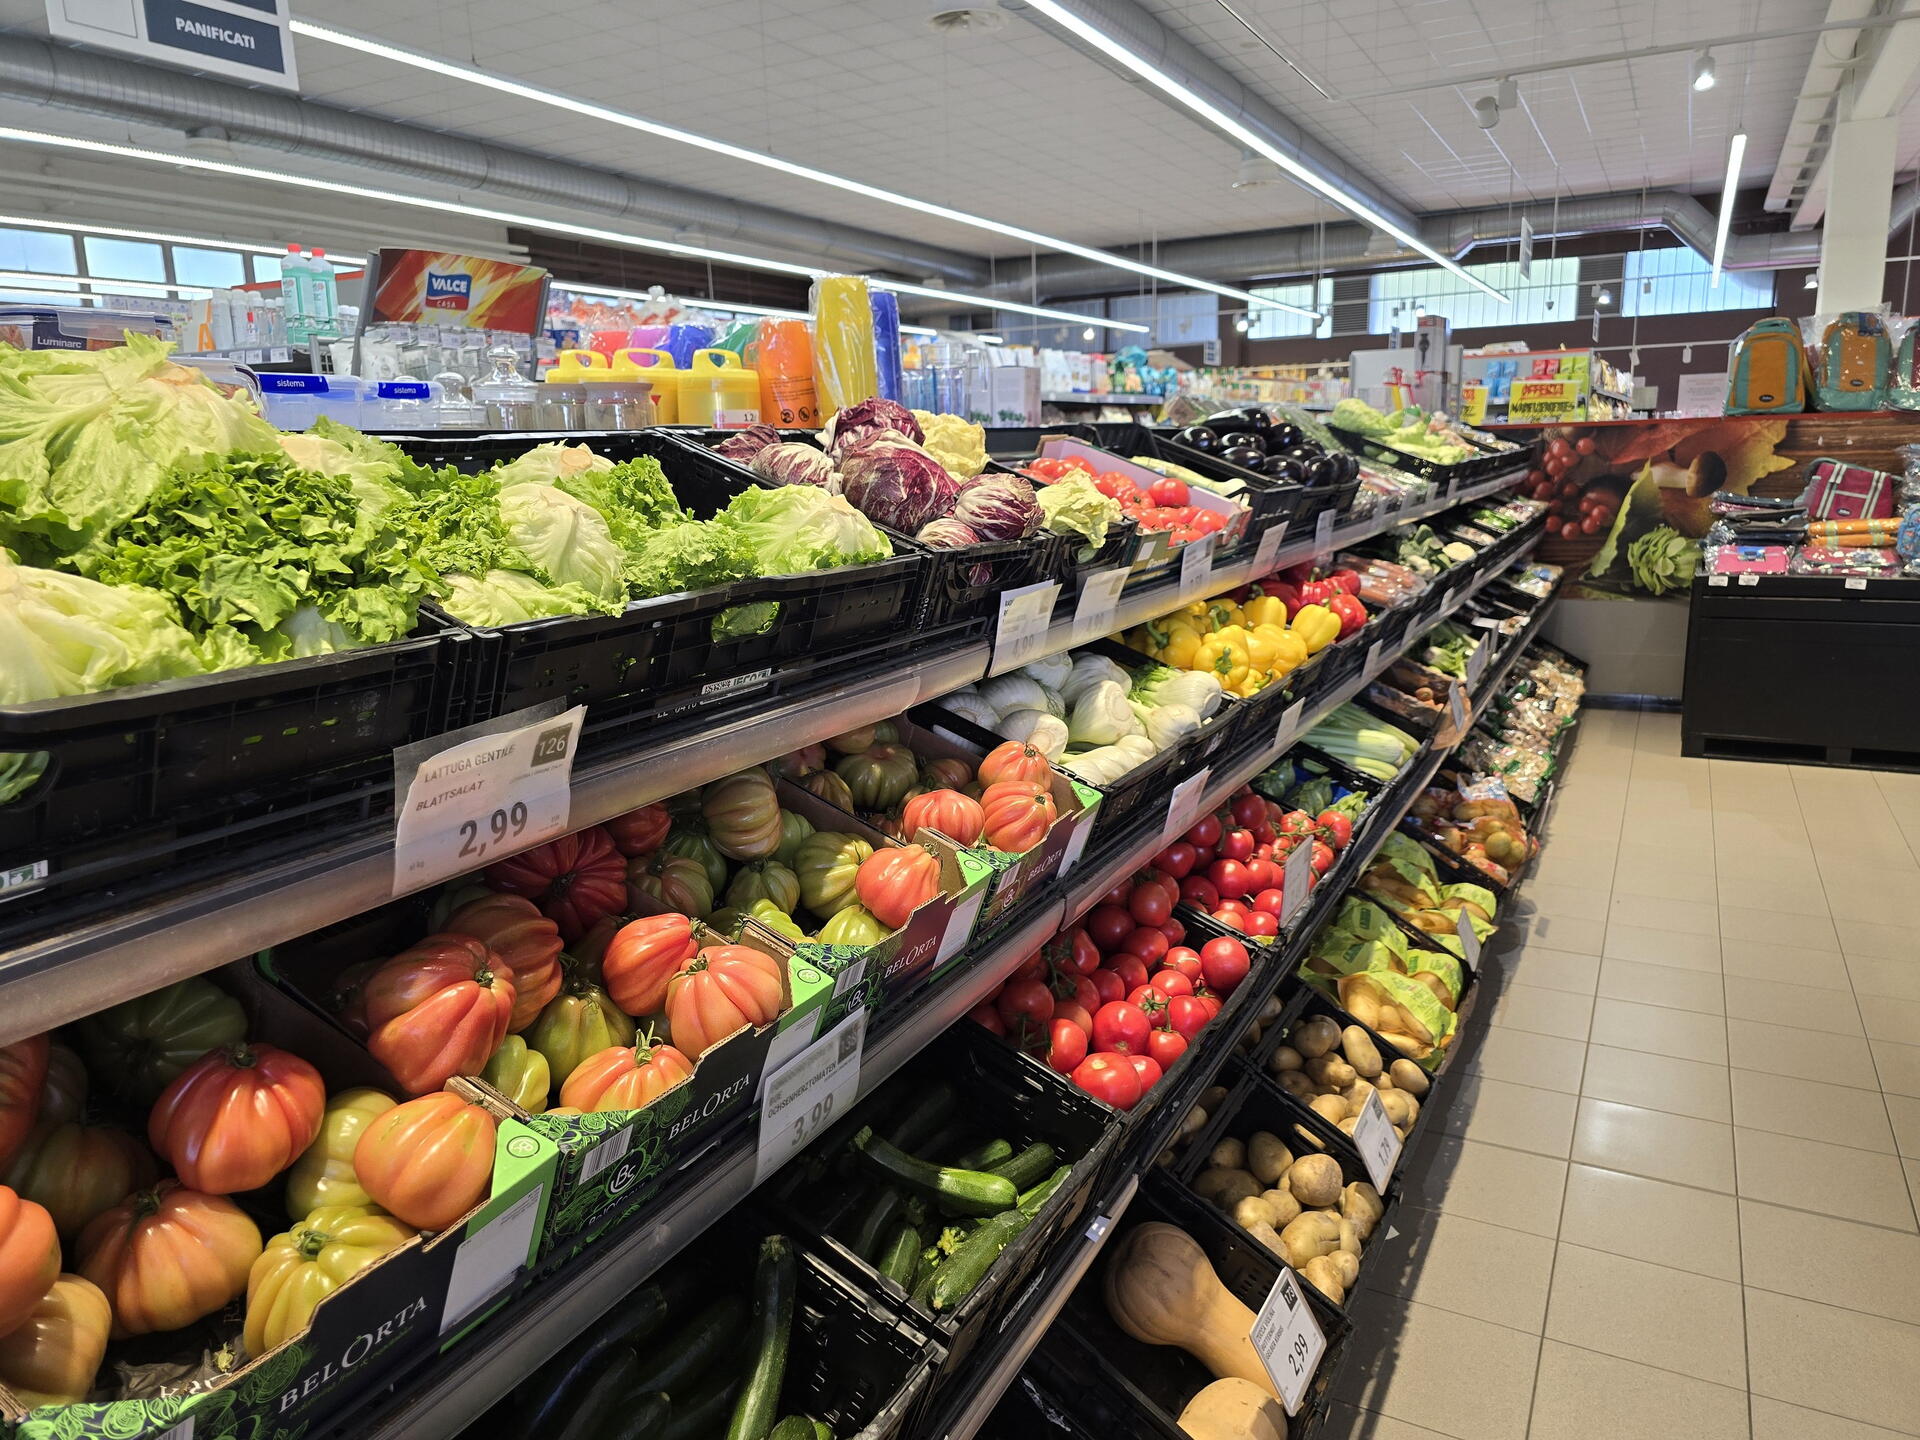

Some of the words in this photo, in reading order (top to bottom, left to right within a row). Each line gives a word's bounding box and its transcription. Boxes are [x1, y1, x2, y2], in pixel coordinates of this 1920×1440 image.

[175, 17, 255, 49] PANIFICATI
[431, 278, 468, 293] VALCE
[37, 336, 82, 349] Luminarc
[276, 379, 306, 388] sistema
[539, 735, 566, 757] 126
[424, 759, 472, 783] LATTUGA
[474, 744, 516, 767] GENTILE
[415, 780, 485, 811] BLATTSALAT
[458, 801, 528, 859] 2,99
[791, 1092, 834, 1147] 3,99
[1288, 1333, 1309, 1377] 2,99
